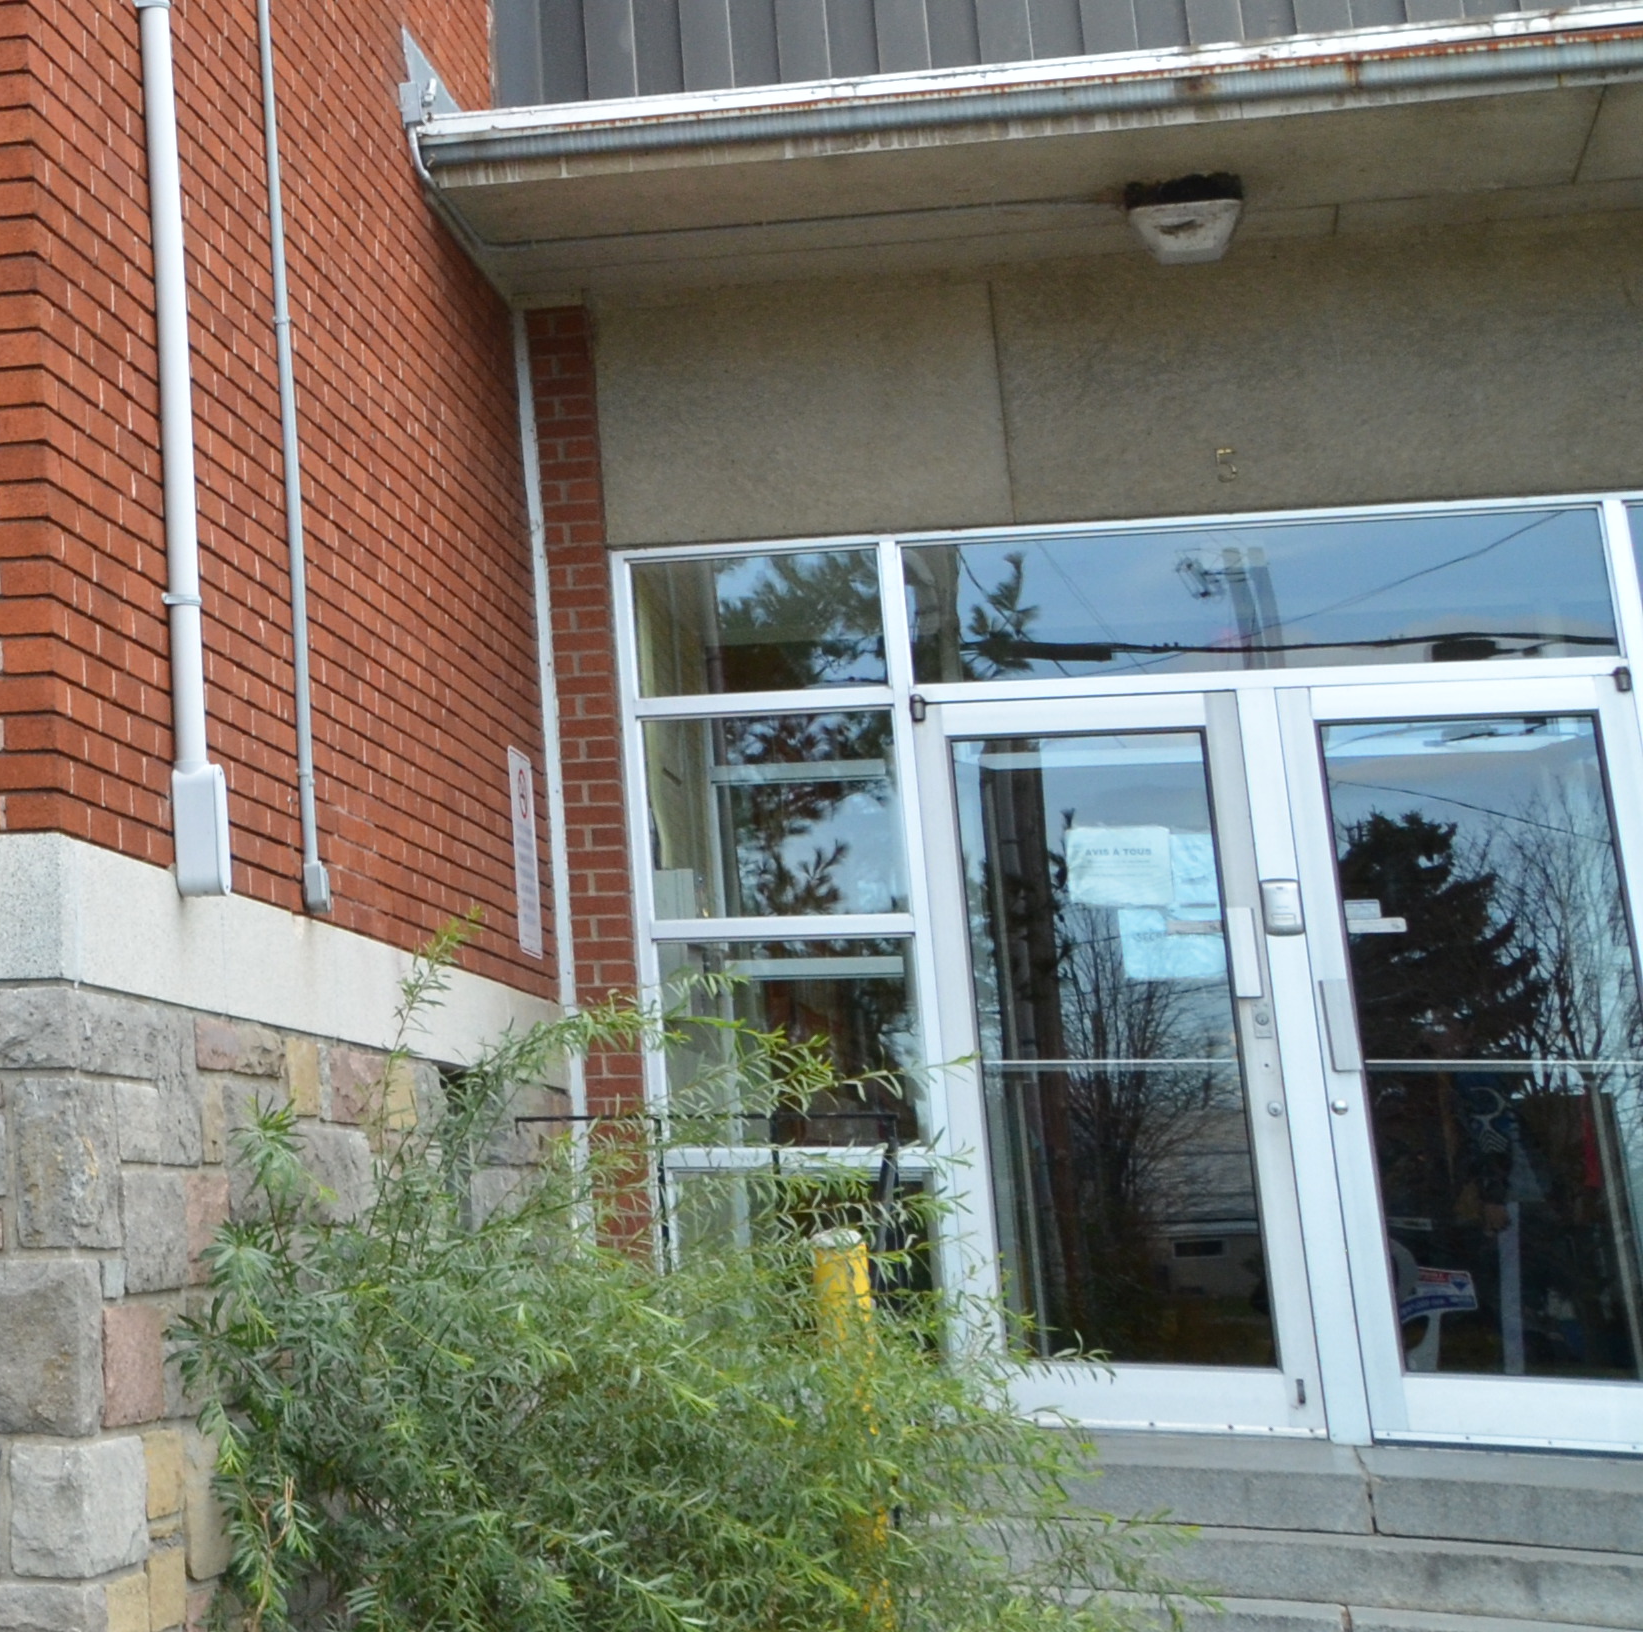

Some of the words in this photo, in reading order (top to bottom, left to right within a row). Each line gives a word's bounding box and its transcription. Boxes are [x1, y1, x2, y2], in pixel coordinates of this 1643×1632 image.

[1216, 448, 1237, 483] 5
[1085, 848, 1109, 856] AVIS
[1123, 848, 1152, 856] TOUS
